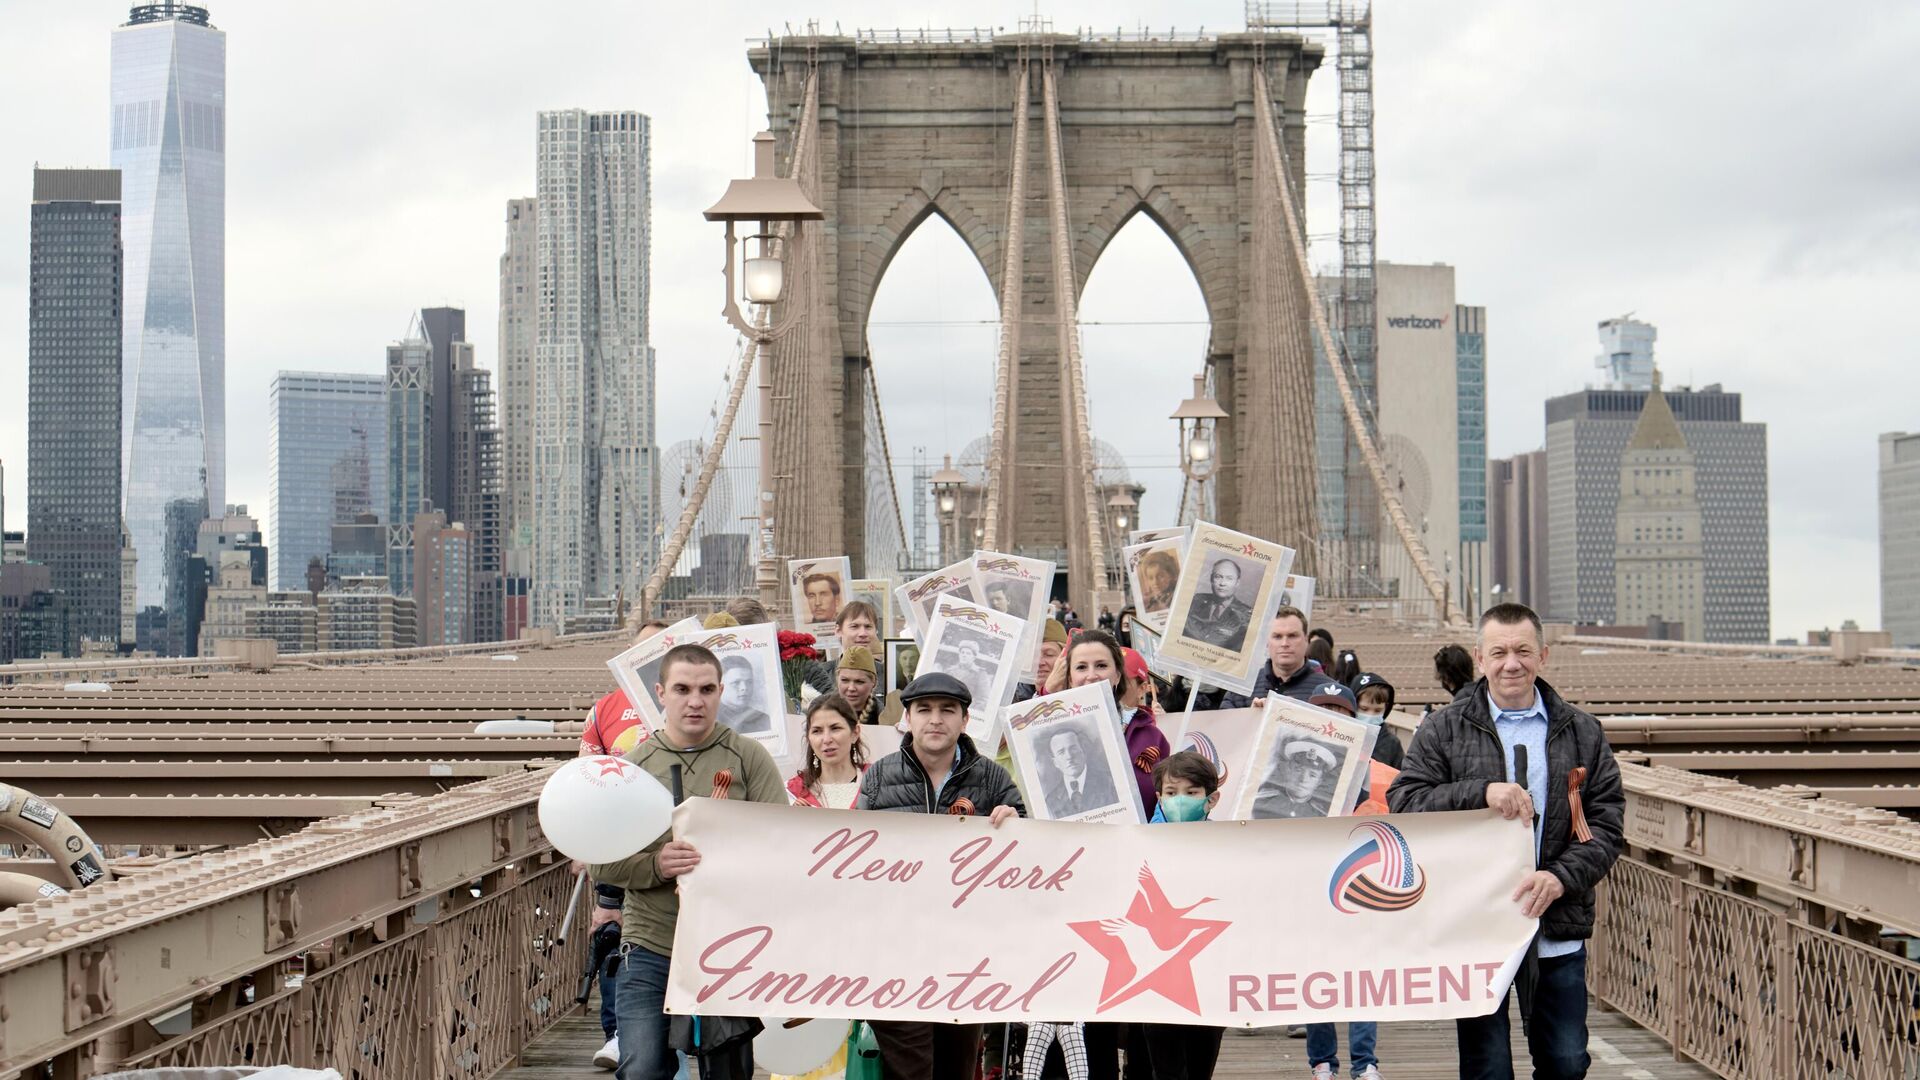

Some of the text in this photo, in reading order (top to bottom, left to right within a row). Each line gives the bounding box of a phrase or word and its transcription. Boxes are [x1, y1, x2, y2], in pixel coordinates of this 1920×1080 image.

[1387, 314, 1442, 329] verizon
[1085, 806, 1127, 822] Тимофеевич
[807, 828, 1086, 909] New York
[696, 925, 1077, 1013] Immortal
[1228, 962, 1505, 1013] REGIMENT
